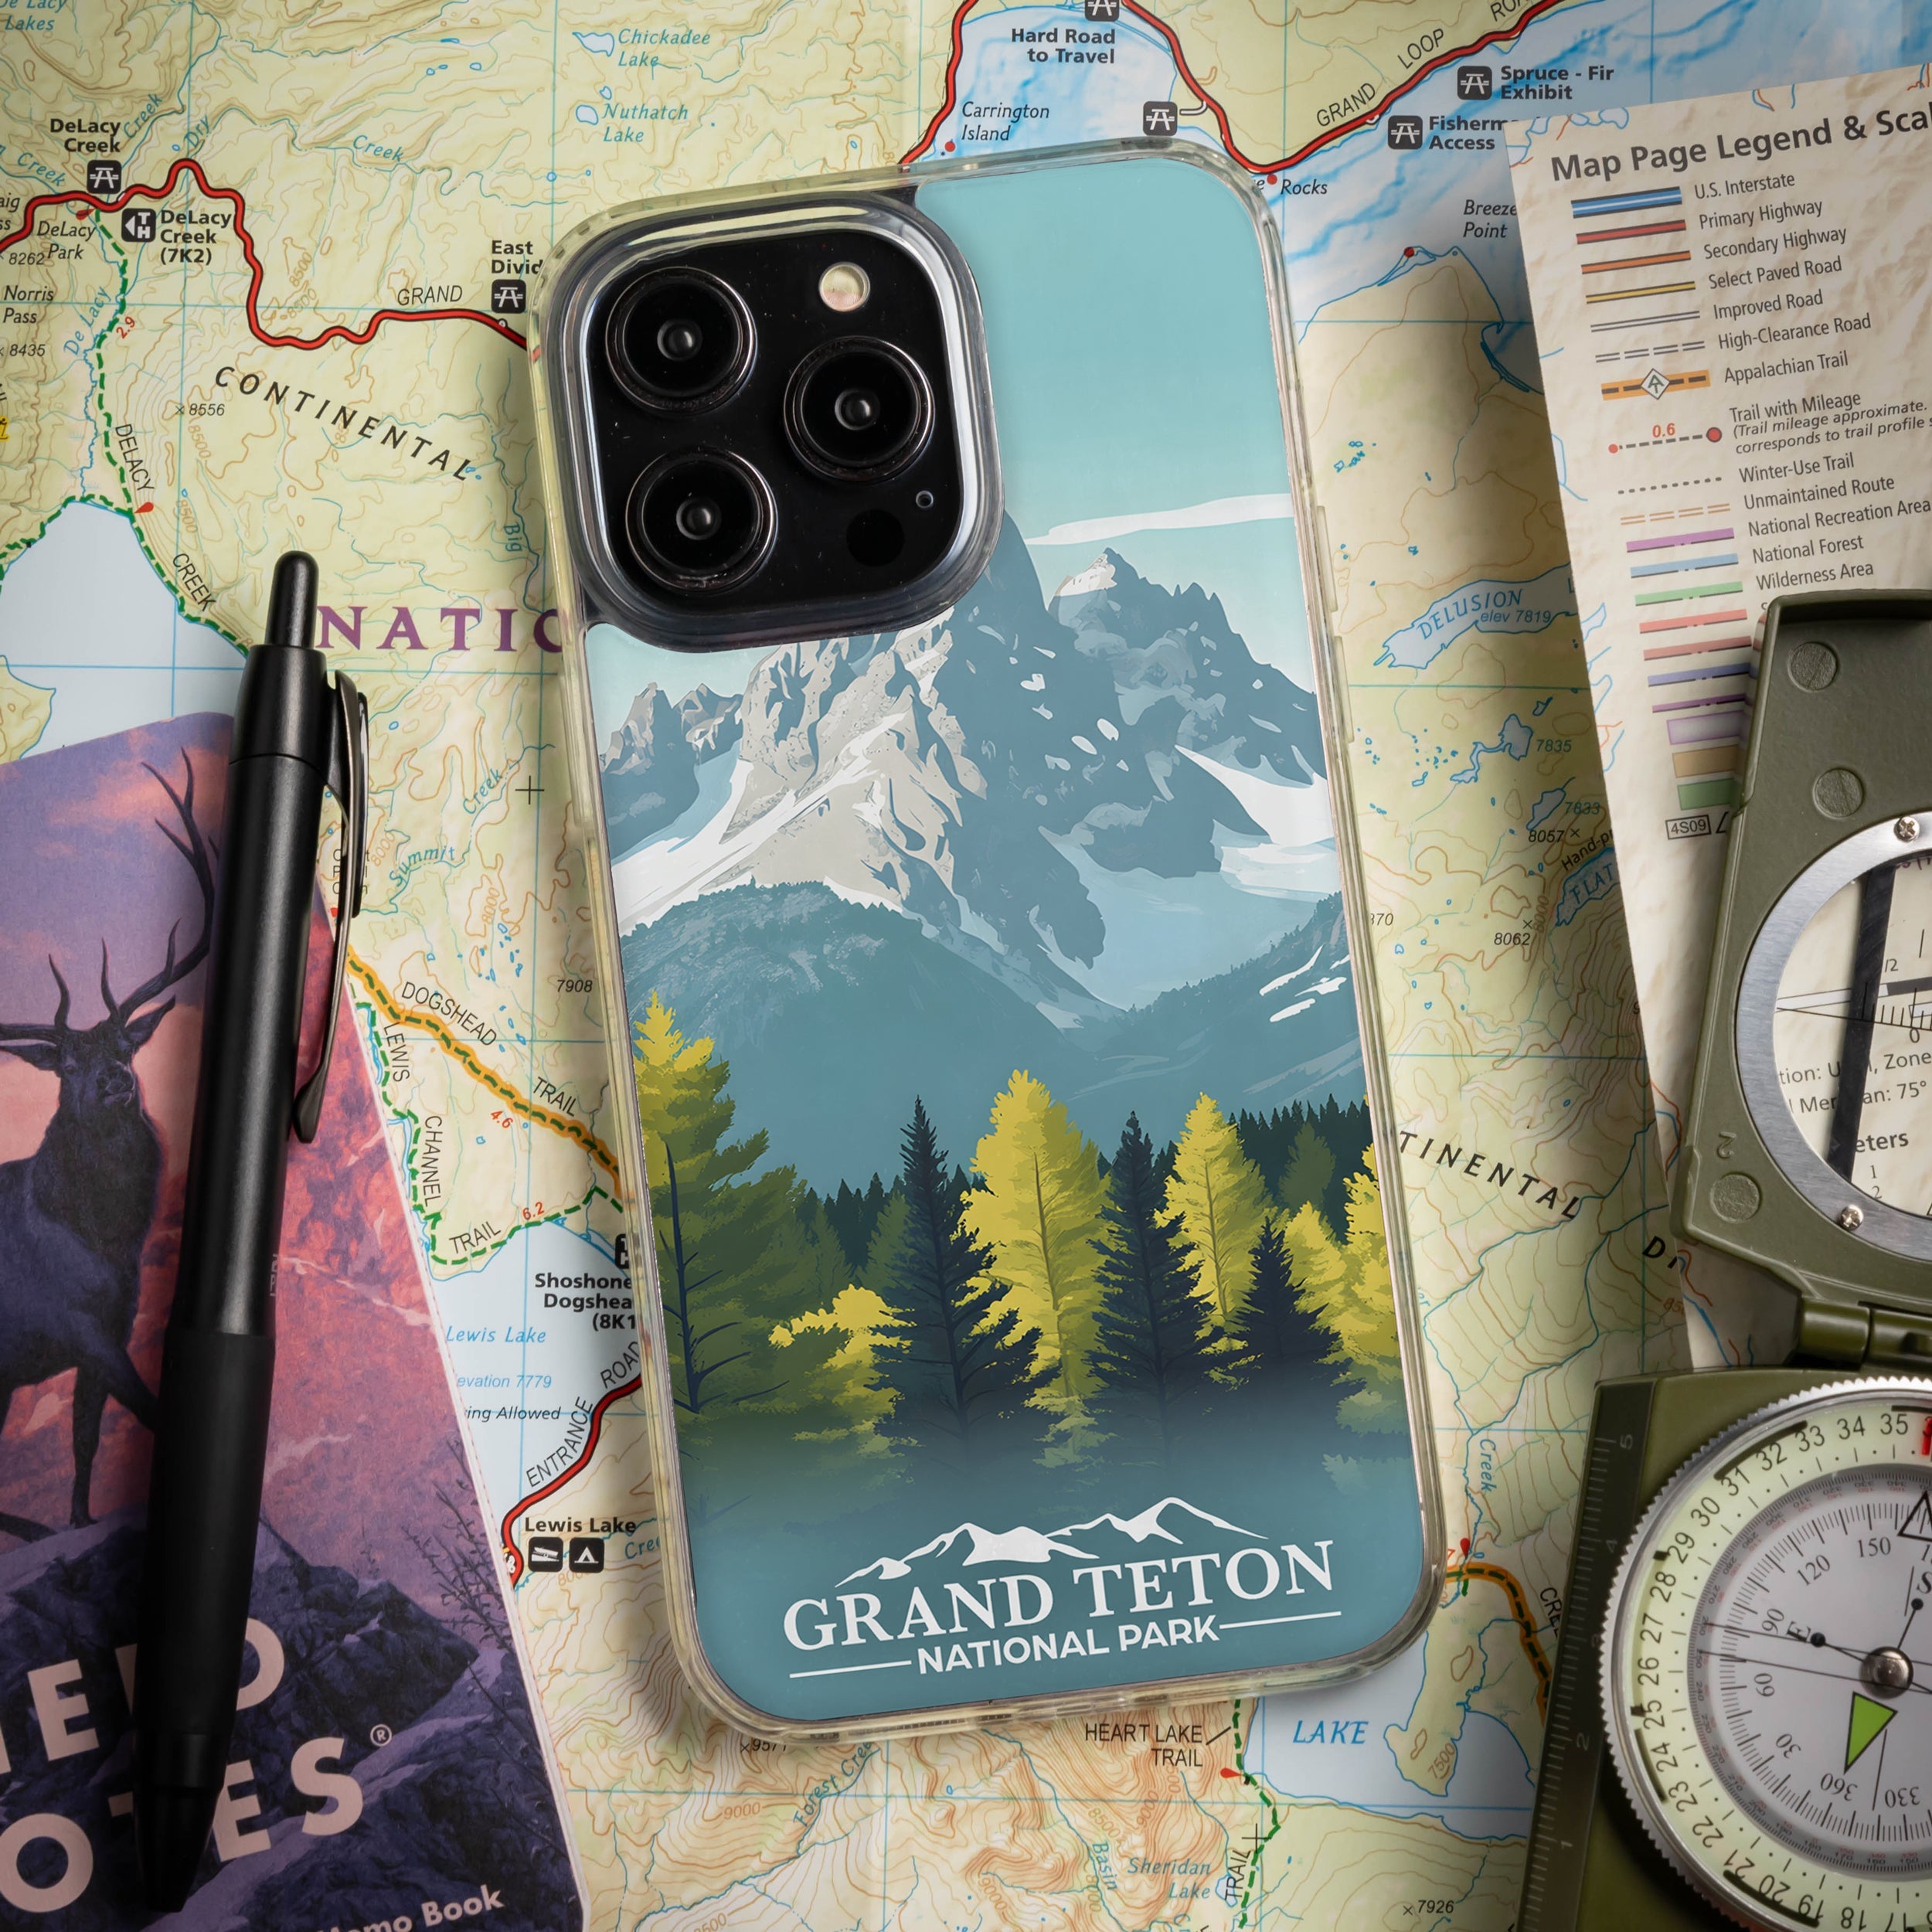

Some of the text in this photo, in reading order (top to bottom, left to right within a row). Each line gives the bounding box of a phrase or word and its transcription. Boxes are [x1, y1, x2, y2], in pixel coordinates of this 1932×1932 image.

[5, 15, 55, 30] Lakes
[617, 29, 710, 46] Chickadee
[1011, 29, 1115, 44] Hard Road
[1397, 28, 1445, 70] LOOP
[617, 51, 658, 67] Lake
[1027, 49, 1114, 63] to Travel
[1501, 66, 1614, 84] Spruce Fir
[1501, 84, 1573, 100] Exhibit
[123, 94, 163, 139] Creek
[602, 104, 689, 121] Nuthatch
[961, 101, 1049, 123] Carrington
[1316, 82, 1376, 128] GRAND
[49, 118, 121, 137] DeLacy
[184, 114, 210, 149] Dry
[604, 128, 644, 143] Lake
[961, 126, 1011, 141] Island
[1429, 116, 1519, 131] Fisherm
[63, 138, 121, 153] Creek
[352, 134, 404, 162] Creek
[1429, 135, 1495, 150] Access
[1551, 154, 1621, 182] Map
[1631, 141, 1706, 172] Page
[1716, 117, 1832, 160] Legend
[1844, 115, 1867, 141] &
[17, 152, 66, 186] Creek
[1280, 179, 1328, 195] Rocks
[1695, 173, 1795, 199] U.S. Interstate
[160, 211, 233, 229] DeLacy
[1699, 201, 1822, 230] Primary Highway
[38, 220, 96, 238] DeLacy
[160, 230, 217, 244] Creek
[1463, 221, 1508, 238] Point
[48, 242, 84, 260] Park
[160, 247, 212, 265] (7K2)
[492, 240, 533, 255] East
[1704, 228, 1846, 259] Secondary Highway
[9, 253, 45, 266] 8262
[492, 259, 543, 274] Divid
[1708, 255, 1842, 290] Select Paved Road
[4, 285, 54, 301] Norris
[397, 285, 462, 306] GRAND
[1713, 288, 1824, 321] Improved Road
[3, 311, 37, 324] Pass
[63, 286, 113, 356] De Lacy
[116, 316, 136, 339] 2.9
[1718, 312, 1872, 351] High-Clearance Road
[9, 345, 46, 357] 8435
[1724, 349, 1849, 385] Appalachian Trail
[189, 403, 225, 416] 8556
[1730, 393, 1861, 423] Trail with Mileage
[1733, 420, 1767, 439] (Trail
[1772, 415, 1828, 433] mileage
[1833, 401, 1927, 423] approximate.
[216, 366, 471, 481] CONTINENTAL
[1652, 423, 1675, 437] 0.6
[1736, 430, 1821, 454] corresponds
[1825, 429, 1840, 441] to
[1845, 423, 1872, 438] trail
[1877, 417, 1924, 437] profile
[115, 423, 155, 492] DELACY
[1740, 452, 1854, 483] Winter-Use Trail
[1744, 478, 1895, 510] Unmaintained Route
[1749, 500, 1931, 536] National Recreation Area
[504, 523, 522, 552] Big
[1753, 536, 1864, 563] National Forest
[172, 553, 217, 612] CREEK
[1756, 563, 1874, 590] Wilderness Area
[1417, 590, 1522, 640] DELUSION
[1481, 611, 1551, 623] elev 7819
[317, 605, 563, 653] NATIO
[1536, 740, 1572, 753] 7835
[463, 769, 503, 815] Creek
[1564, 801, 1600, 815] 7833
[1529, 830, 1564, 843] 8057
[1671, 818, 1706, 835] 4S09
[389, 845, 455, 887] Summit
[1570, 862, 1613, 904] FLAT
[1494, 932, 1531, 946] 8062
[556, 979, 593, 993] 7908
[401, 981, 497, 1046] DOGSHEAD
[384, 1022, 410, 1082] LEWIS
[1884, 1052, 1932, 1070] Zone
[533, 1077, 579, 1117] TRAIL
[490, 1110, 513, 1128] 4.6
[422, 1115, 442, 1207] CHANNEL
[1400, 1131, 1581, 1219] TINENTAL
[522, 1202, 544, 1220] 6.2
[449, 1221, 502, 1254] TRAIL
[535, 1272, 631, 1289] Shoshone
[544, 1292, 632, 1313] Dogshea
[446, 1326, 546, 1343] Lewis Lake
[516, 1375, 552, 1388] 7779
[496, 1406, 562, 1420] Allowed
[1879, 1413, 1908, 1435] 35
[1836, 1416, 1866, 1440] 34
[526, 1396, 593, 1487] ENTRANCE
[1479, 1438, 1497, 1492] Creek
[1720, 1467, 1750, 1496] 31
[1690, 1496, 1720, 1527] 30
[525, 1518, 636, 1533] Lewis Lake
[1858, 1536, 1891, 1558] 150
[1797, 1554, 1832, 1587] 120
[782, 1540, 1335, 1651] GRAND TETON
[1761, 1608, 1784, 1633] 90
[917, 1614, 1221, 1675] NATIONAL PARK
[1638, 1657, 1660, 1685] 26
[1753, 1672, 1775, 1697] 60
[1643, 1699, 1666, 1730] 25
[1085, 1723, 1202, 1743] HEART LAKE
[1292, 1720, 1369, 1744] LAKE
[1151, 1748, 1202, 1767] TRAIL
[1776, 1733, 1801, 1759] 30
[1820, 1773, 1858, 1801] 360
[1885, 1787, 1920, 1808] 330
[793, 1774, 838, 1827] Forest
[1092, 1841, 1118, 1890] Basin
[1127, 1857, 1211, 1875] Sheridan
[1225, 1849, 1251, 1900] TRAIL
[1724, 1850, 1756, 1879] 21
[1168, 1882, 1211, 1899] Lake
[1758, 1874, 1791, 1903] 20
[421, 1884, 505, 1927] Book
[1417, 1900, 1454, 1913] 7926
[1798, 1894, 1825, 1921] 19
[1841, 1906, 1866, 1931] 18
